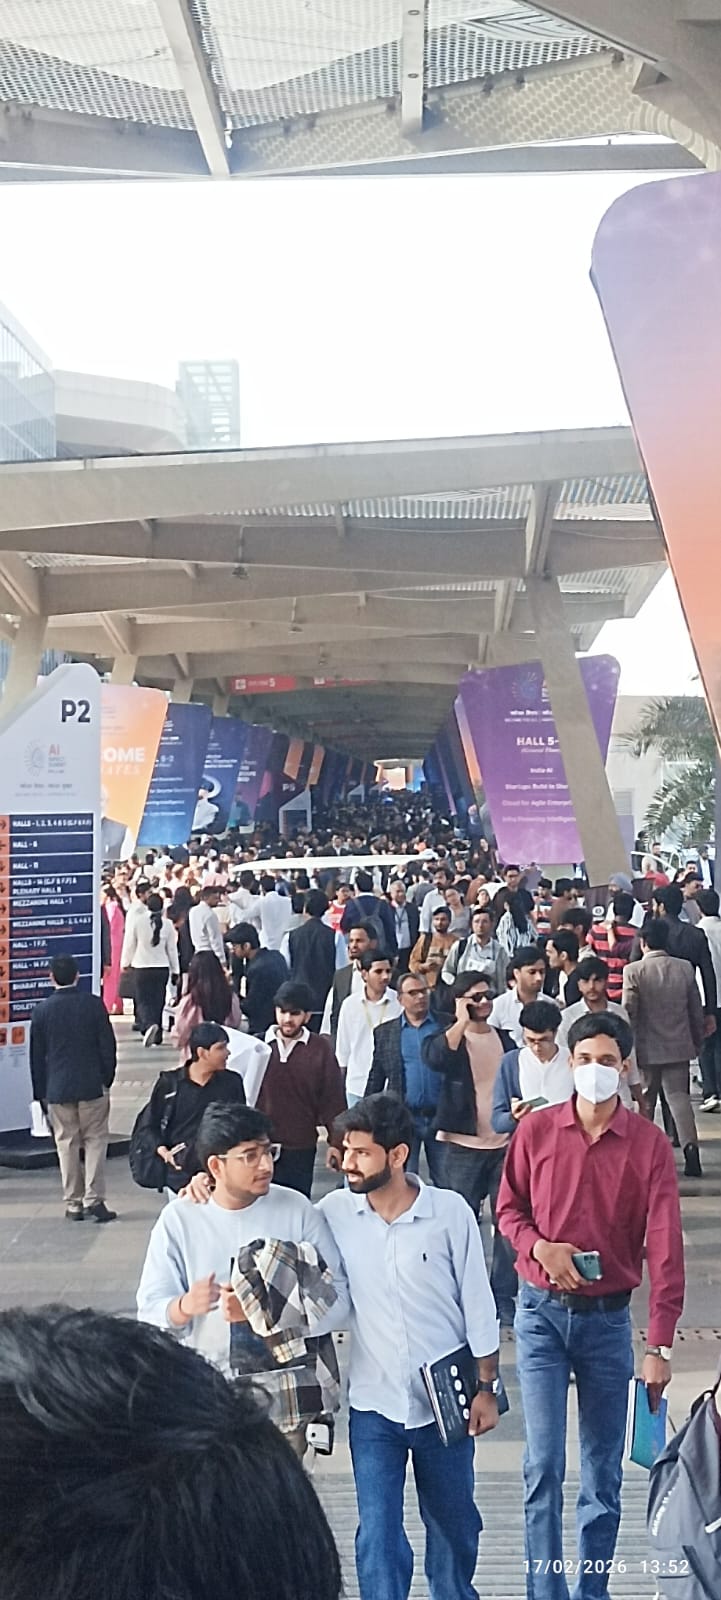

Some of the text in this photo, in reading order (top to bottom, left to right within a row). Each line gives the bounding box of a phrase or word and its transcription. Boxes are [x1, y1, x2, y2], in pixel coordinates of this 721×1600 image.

[62, 700, 90, 722] P2
[516, 736, 560, 746] HALL 5-
[48, 744, 60, 756] AI
[102, 747, 144, 762] OME
[106, 764, 140, 775] ATES
[12, 982, 37, 990] BHARAT
